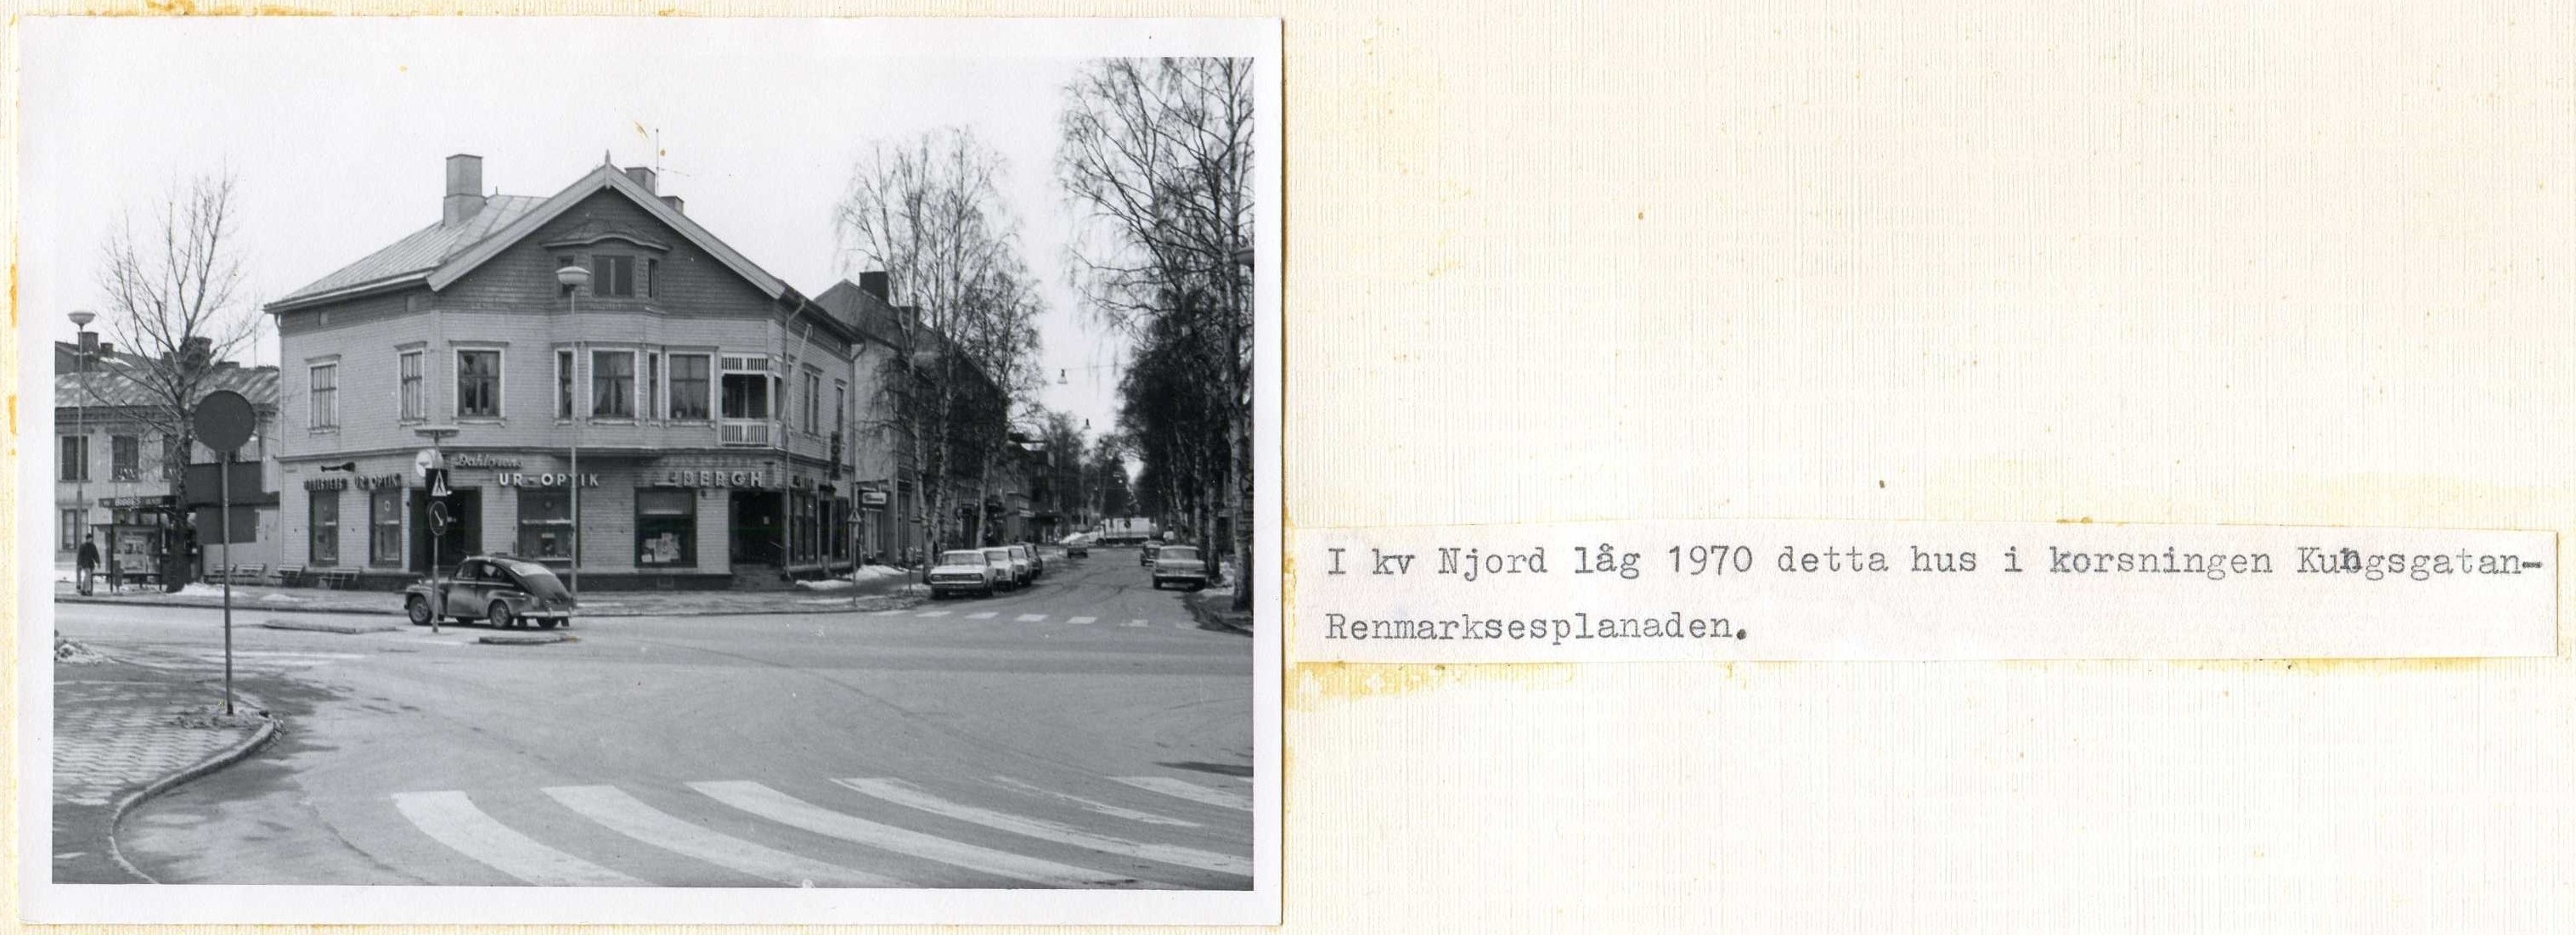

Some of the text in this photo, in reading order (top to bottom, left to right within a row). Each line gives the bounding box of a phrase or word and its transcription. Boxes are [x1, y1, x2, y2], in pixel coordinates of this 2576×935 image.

[1327, 547, 1346, 575] I
[1372, 547, 1415, 575] kv
[1437, 546, 1547, 582] Njord
[1574, 542, 1640, 579] låg
[1668, 544, 1753, 576] 1970
[1777, 544, 1889, 573] detta
[1910, 544, 1977, 573] hus
[2004, 545, 2023, 573] i
[2049, 545, 2274, 580] korsningen
[1325, 611, 1747, 645] Renmarksesplanaden.
